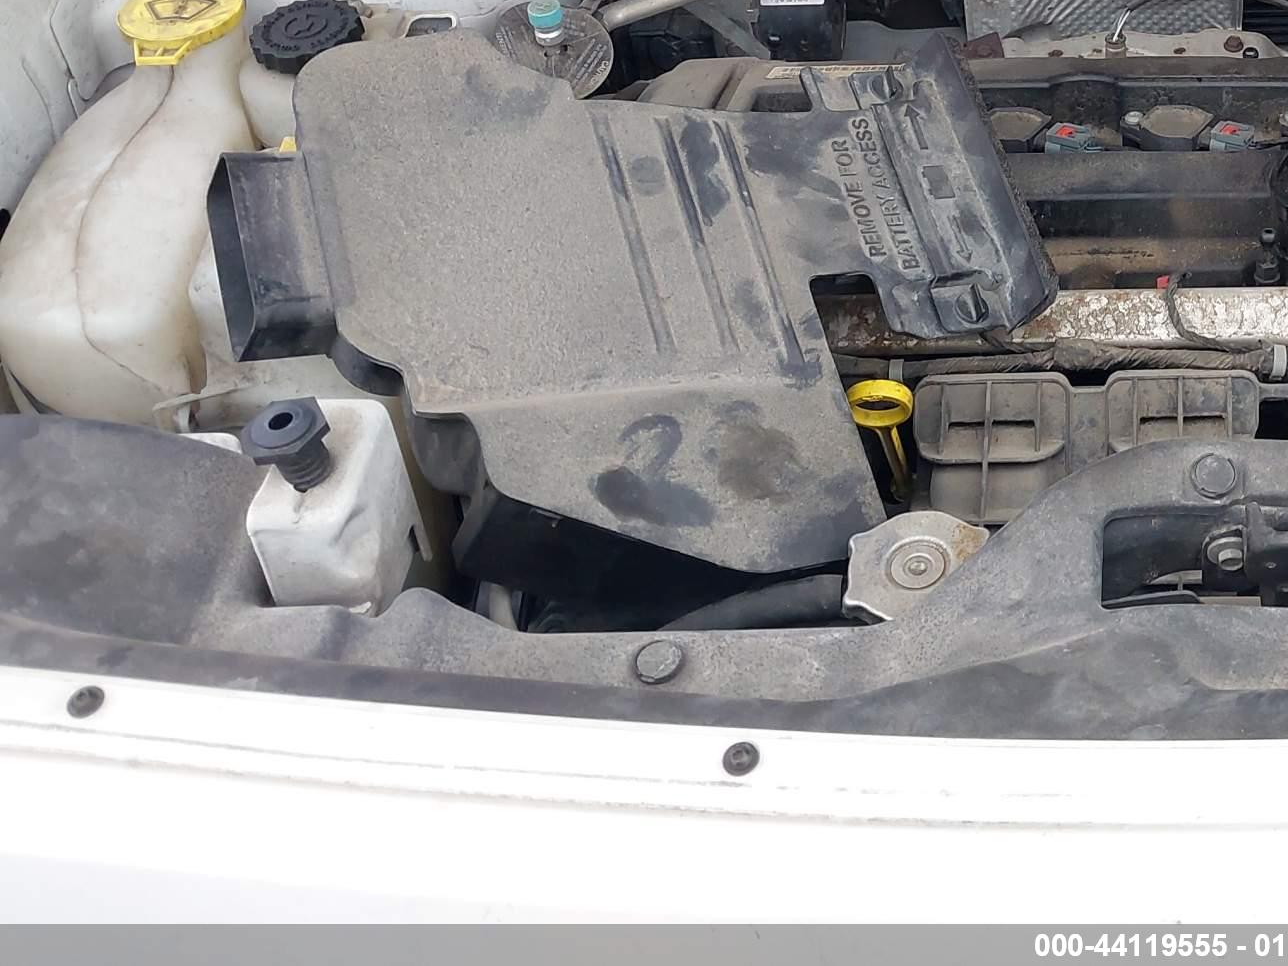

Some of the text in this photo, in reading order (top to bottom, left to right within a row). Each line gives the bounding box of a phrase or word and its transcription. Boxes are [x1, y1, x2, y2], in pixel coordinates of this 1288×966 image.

[830, 139, 888, 258] REMOVE FOR
[851, 117, 920, 271] BATTERY ACCESS
